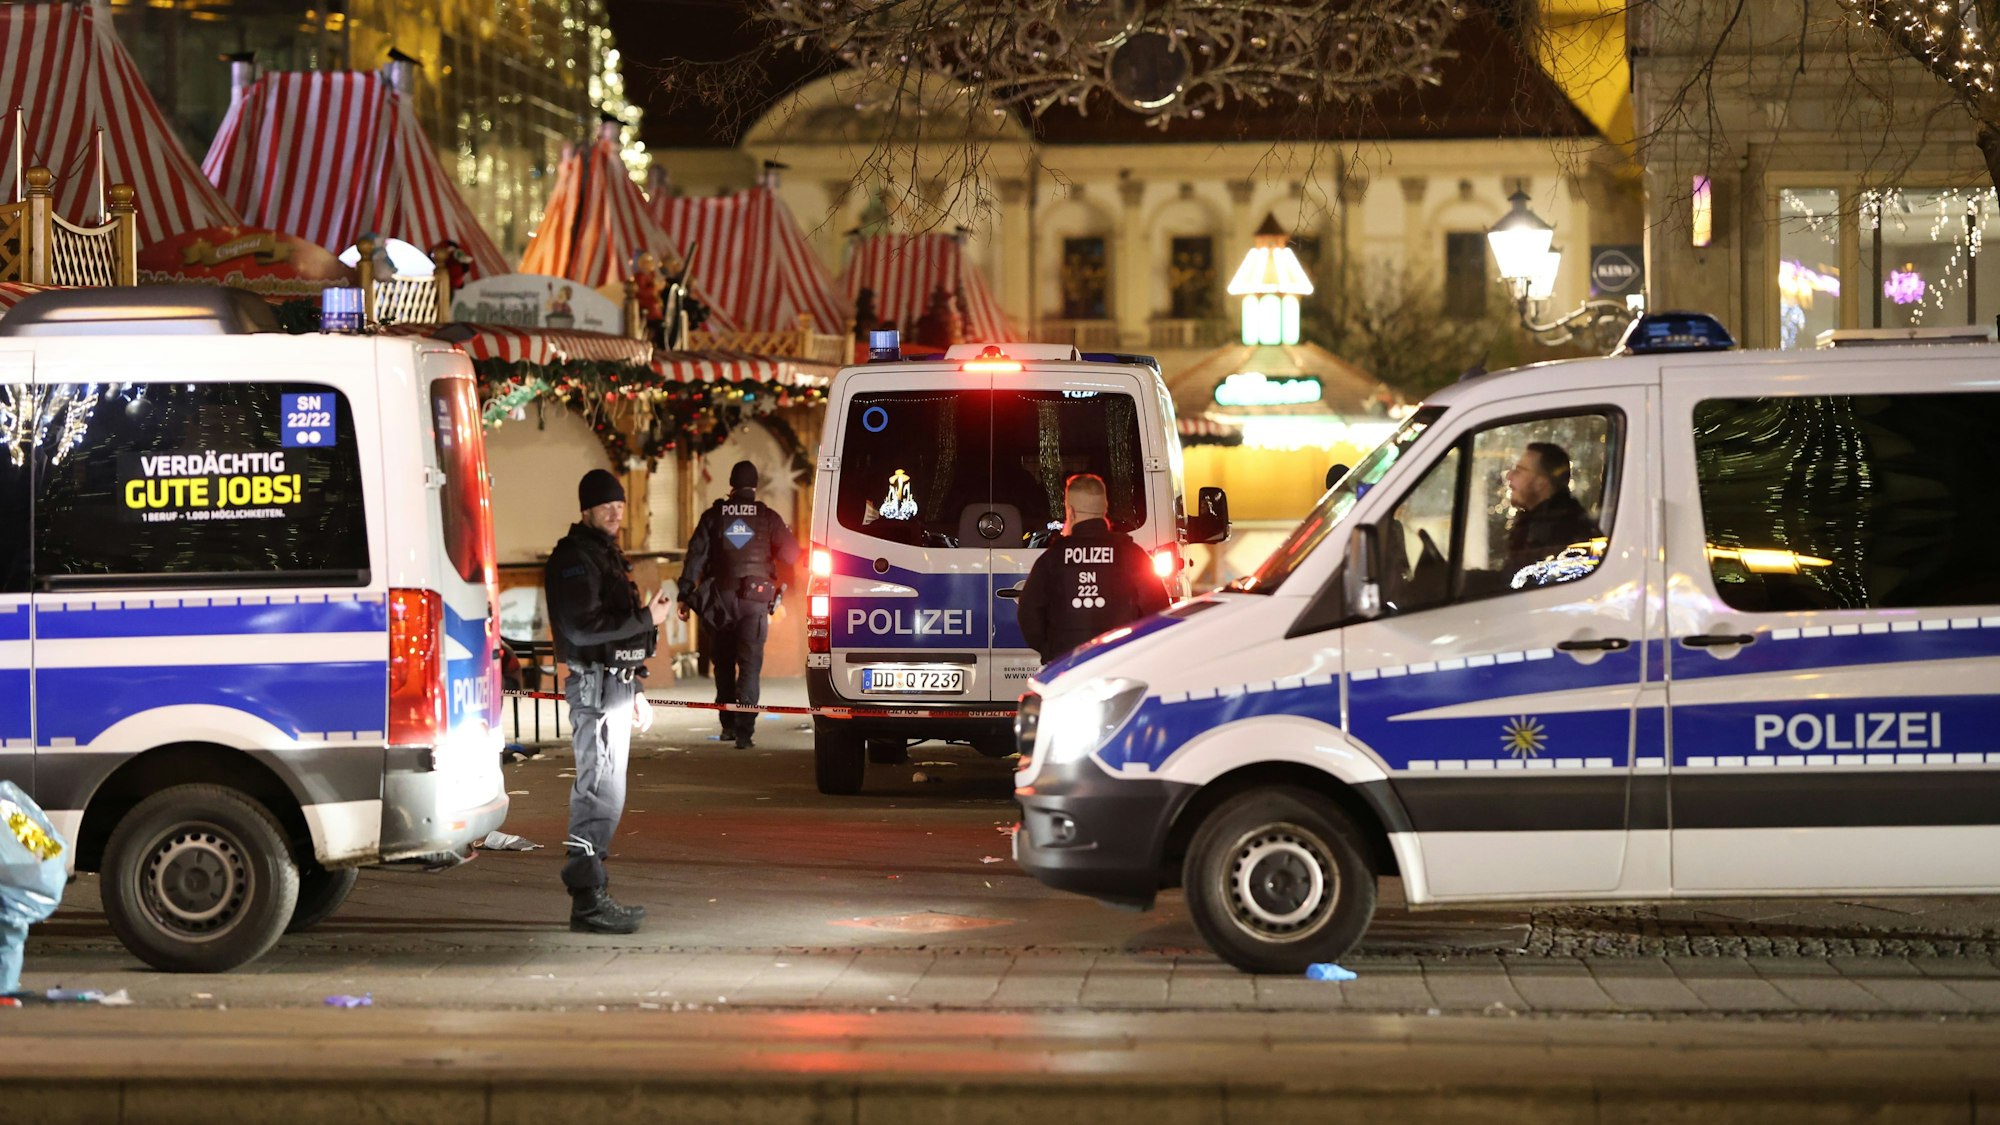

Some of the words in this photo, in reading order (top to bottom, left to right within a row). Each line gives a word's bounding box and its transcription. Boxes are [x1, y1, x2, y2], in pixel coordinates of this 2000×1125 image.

[1598, 264, 1632, 277] KIND
[297, 396, 321, 410] SN
[287, 412, 330, 428] 22/22
[141, 451, 285, 477] VERDÄCHTIG
[125, 477, 209, 509] GUTE
[217, 474, 301, 508] JOBS!
[148, 511, 178, 522] BERUF
[186, 510, 210, 521] 1.000
[211, 508, 285, 520] MÖGLICHKEITEN.
[722, 504, 757, 516] POLIZEI
[733, 525, 746, 533] SN
[1064, 547, 1114, 564] POLIZEI
[1079, 572, 1096, 583] SN
[1078, 585, 1098, 597] 222
[848, 608, 972, 635] POLIZEI
[615, 649, 645, 660] POLIZEI
[873, 672, 895, 688] DD
[906, 672, 916, 688] Q
[920, 672, 960, 688] 7239
[1755, 712, 1942, 751] POLIZEI
